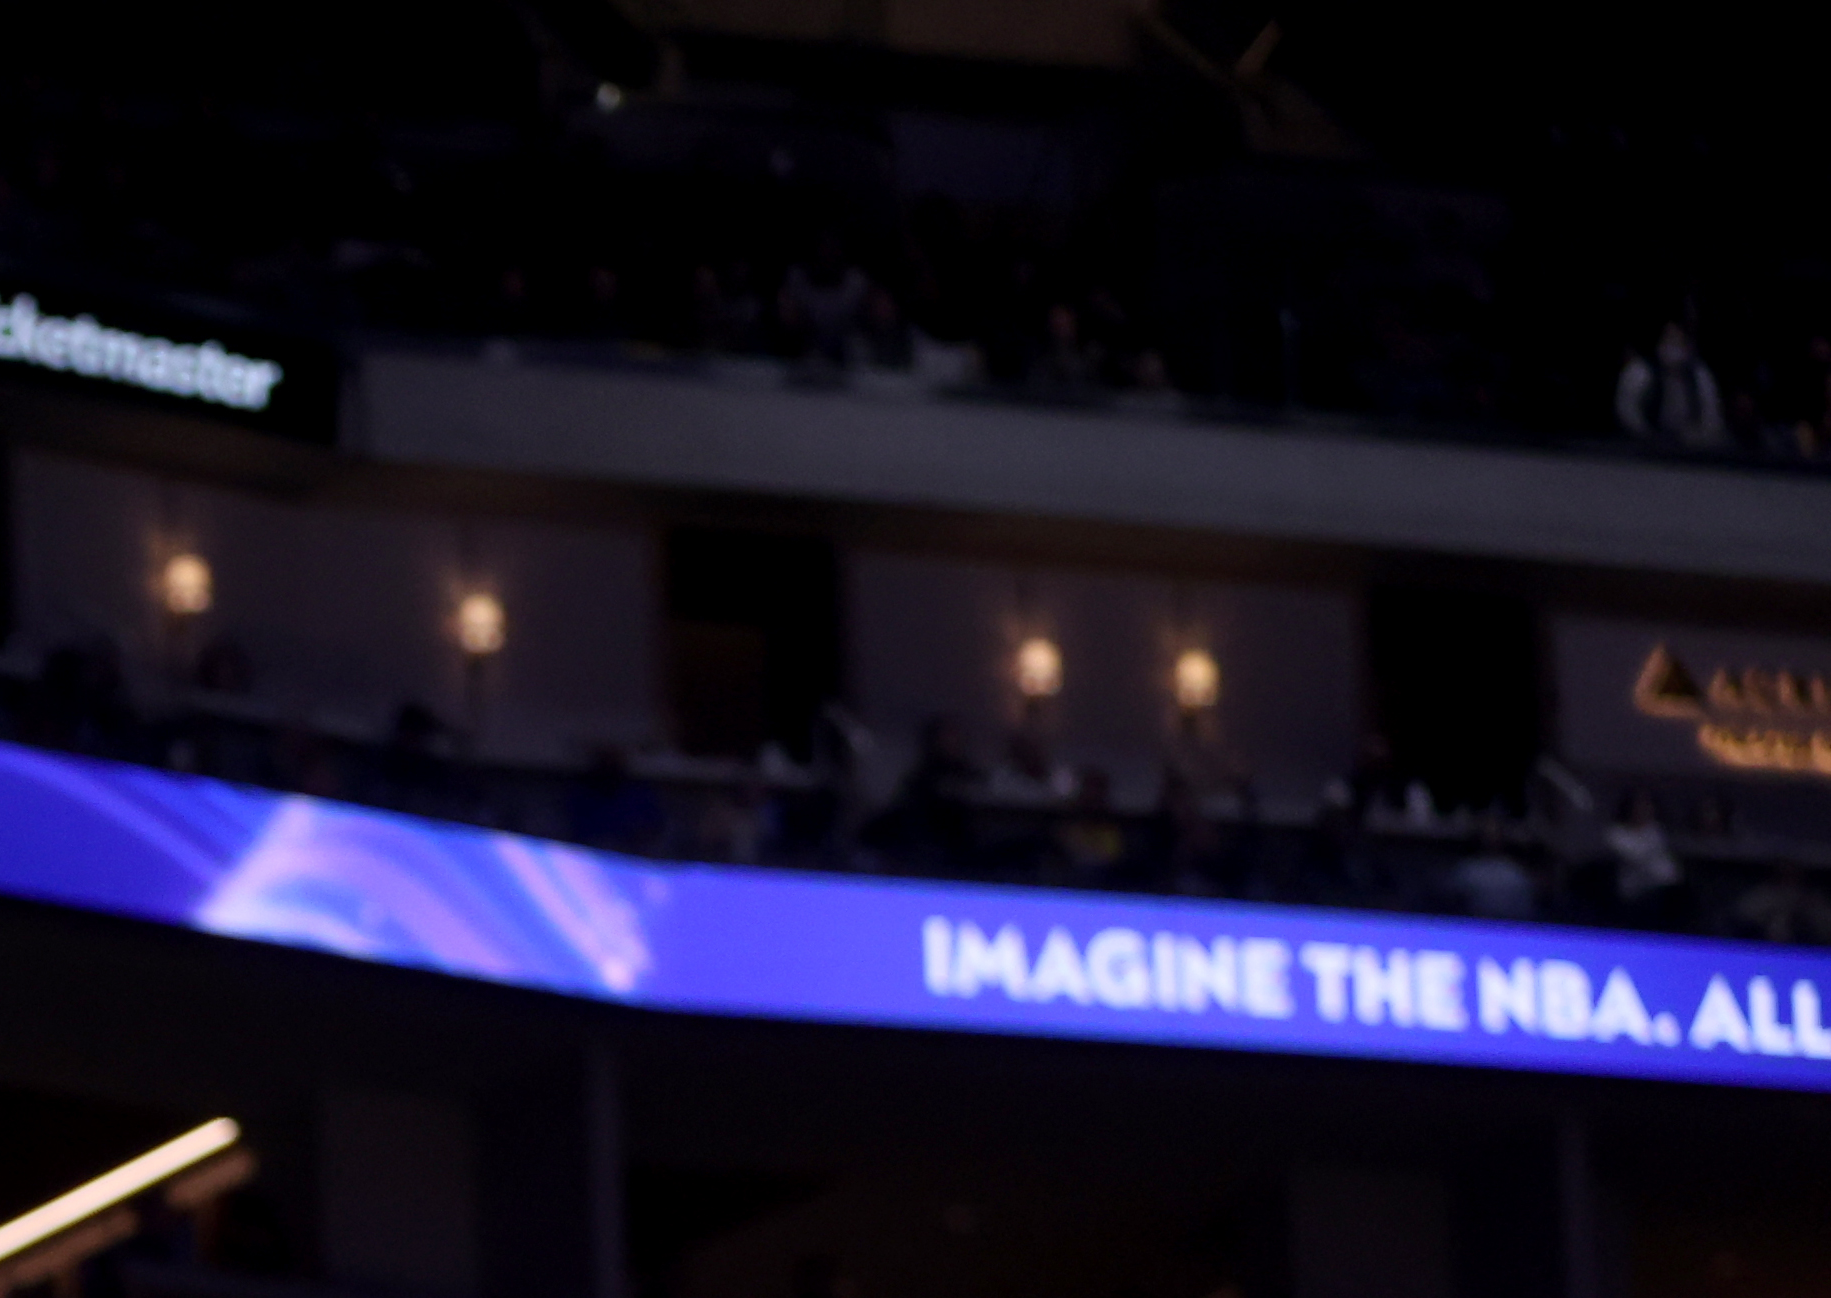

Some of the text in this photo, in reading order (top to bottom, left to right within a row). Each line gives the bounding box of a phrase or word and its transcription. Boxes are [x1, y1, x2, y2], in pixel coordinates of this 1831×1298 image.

[922, 914, 1297, 1020] IMAGINE
[1300, 940, 1470, 1032] THE
[1477, 955, 1682, 1048] NBA.
